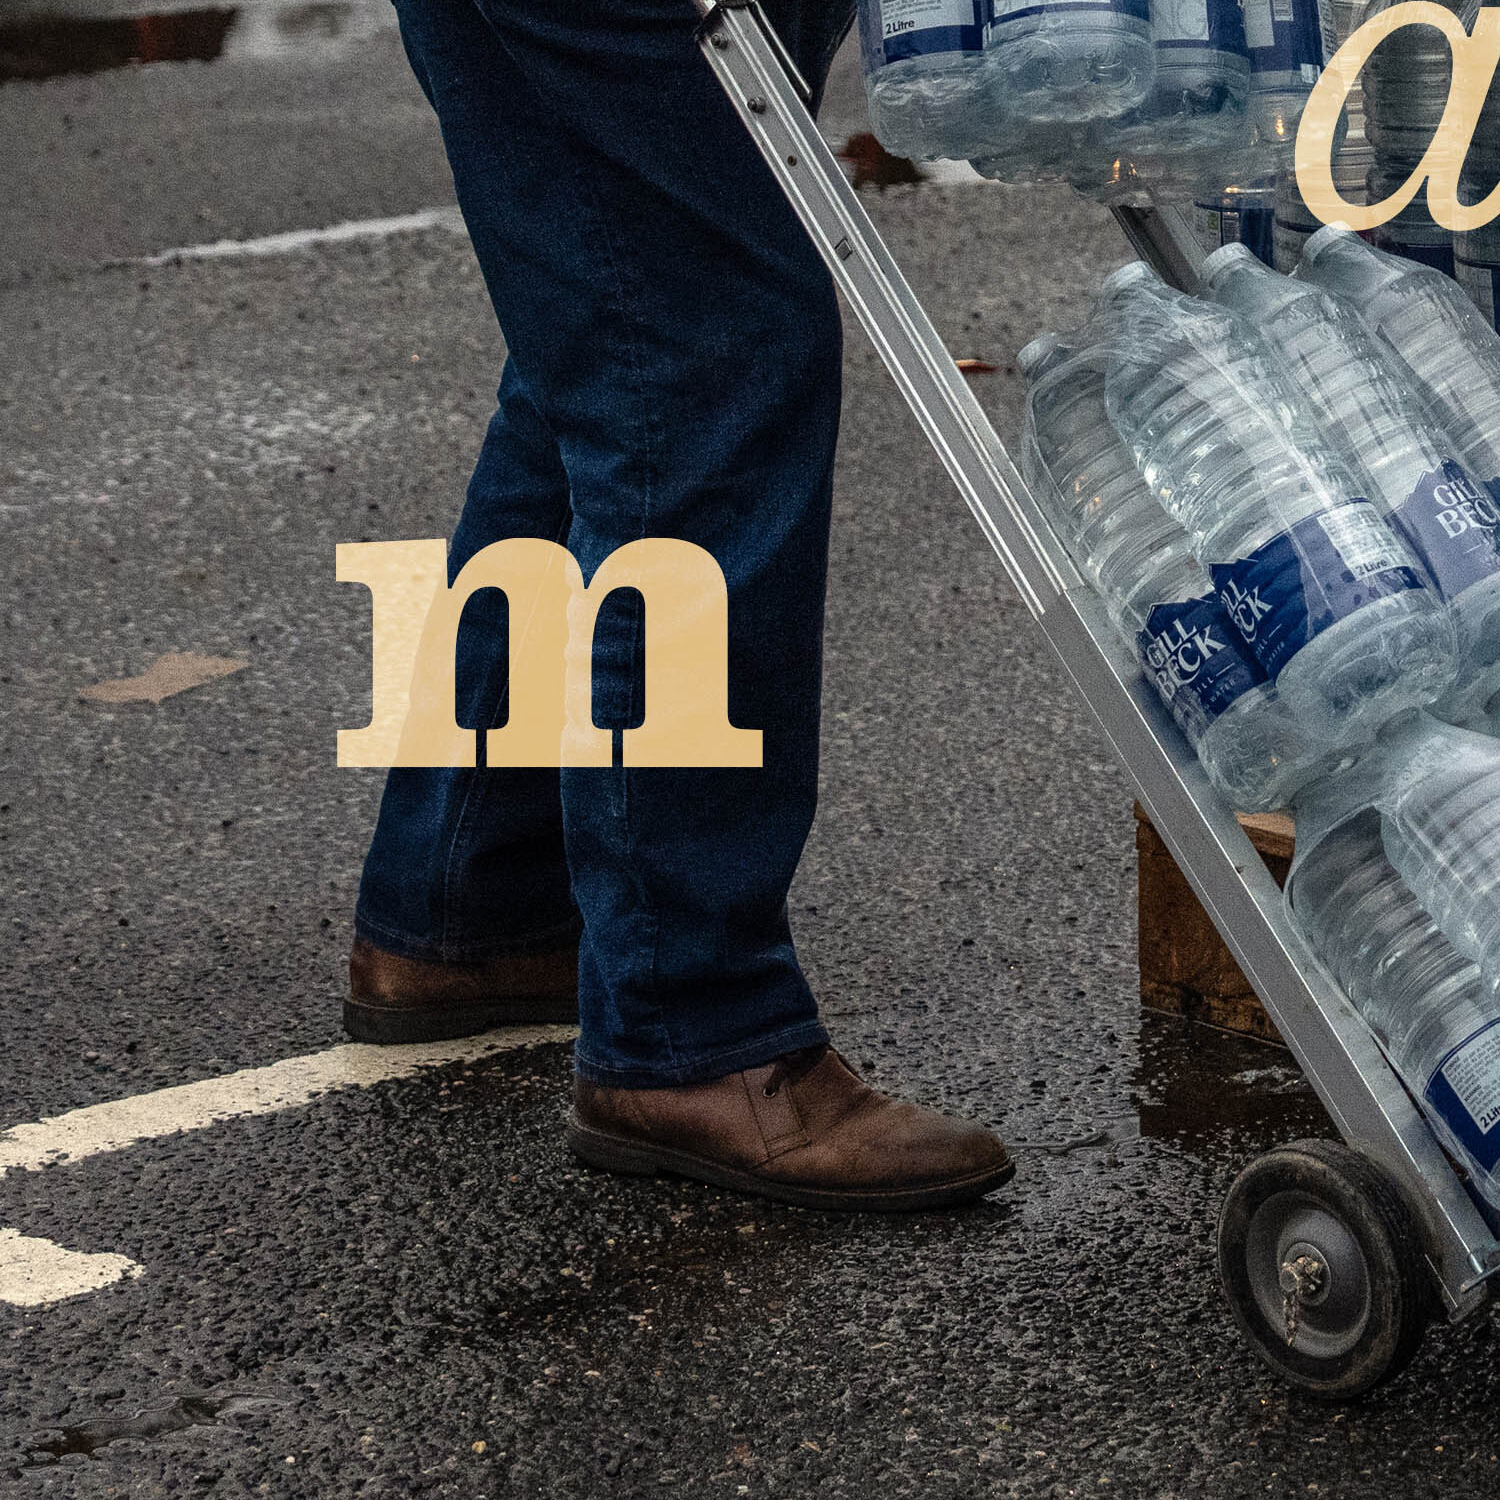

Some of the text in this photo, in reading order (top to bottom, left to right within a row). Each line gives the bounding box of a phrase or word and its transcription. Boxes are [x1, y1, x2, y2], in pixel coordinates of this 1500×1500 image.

[886, 19, 915, 35] 2 Litre
[1146, 617, 1198, 669] GILL
[1155, 624, 1227, 701] BECK
[1480, 1116, 1490, 1128] 2
